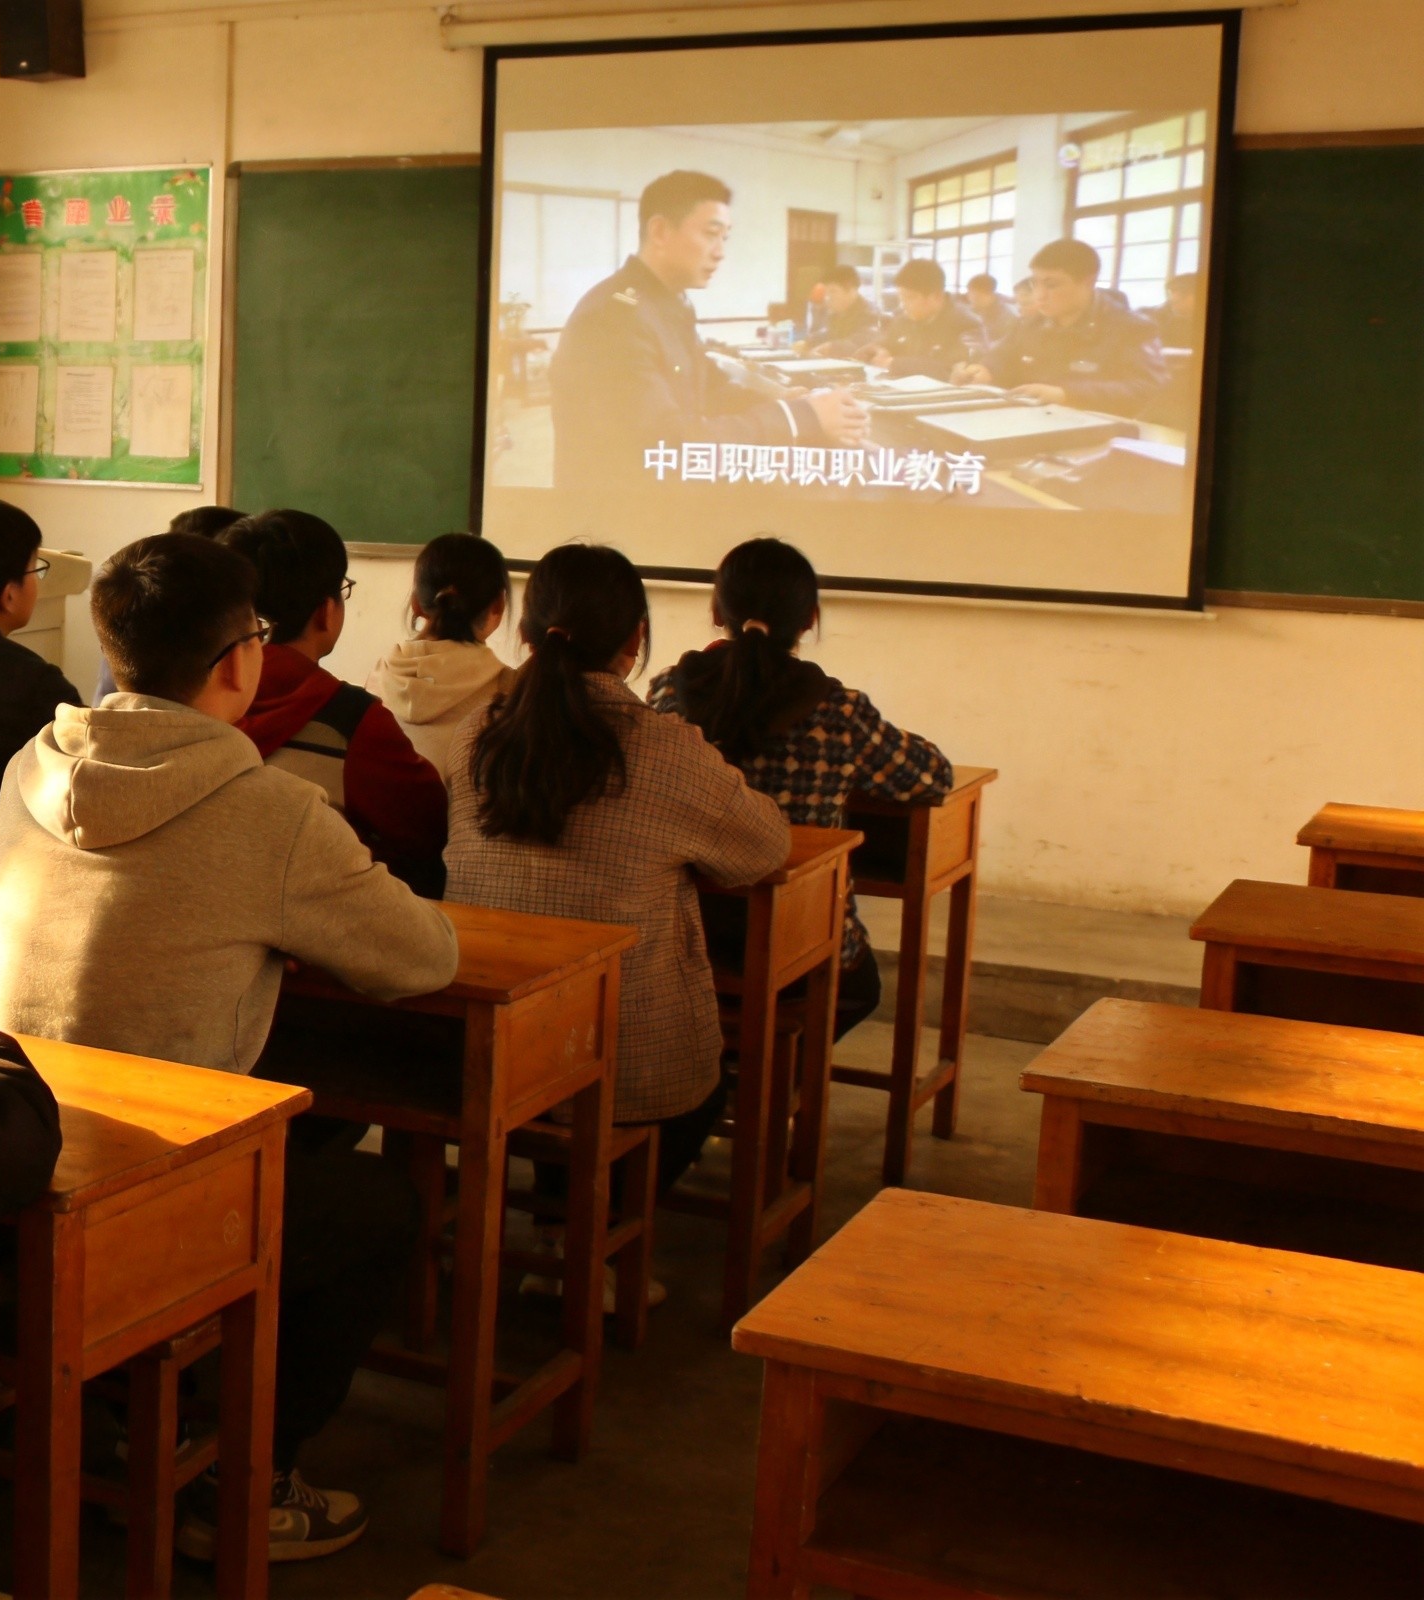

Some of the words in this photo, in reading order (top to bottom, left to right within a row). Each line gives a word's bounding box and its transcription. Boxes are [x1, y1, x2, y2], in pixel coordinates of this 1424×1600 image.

[644, 440, 986, 494] 中国职职职职业教育
